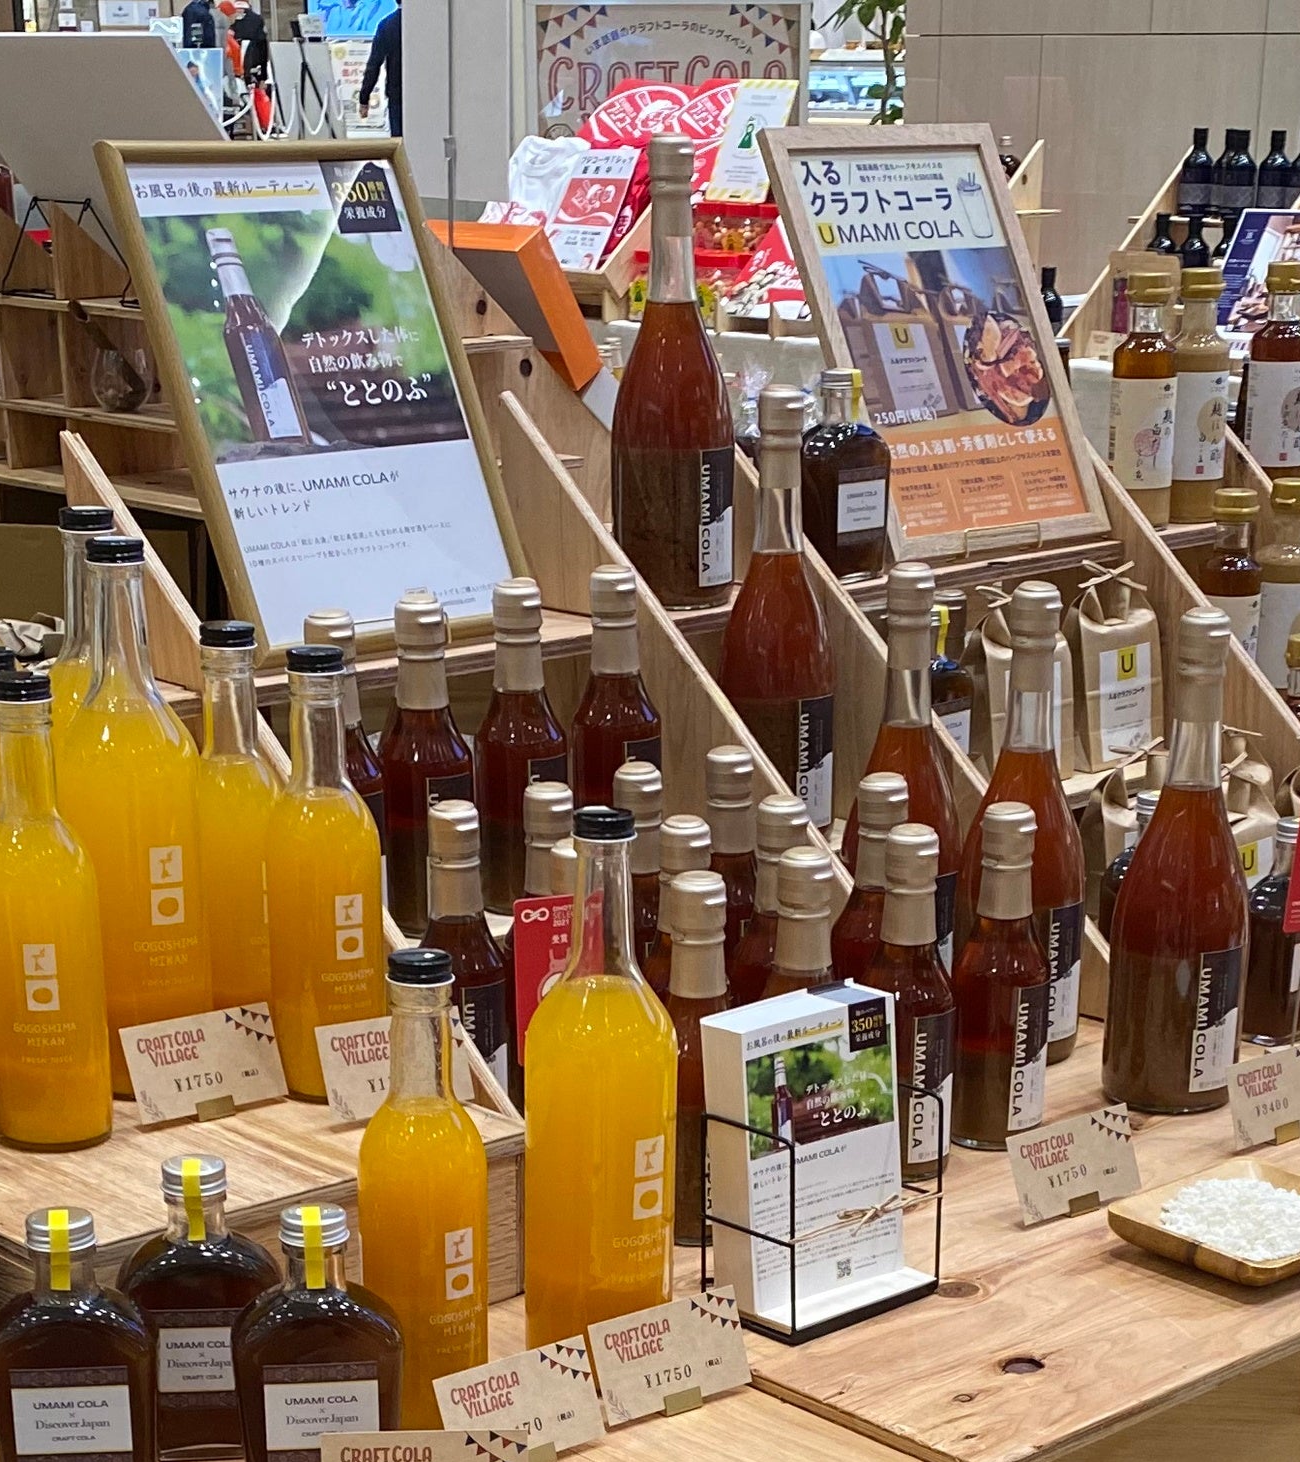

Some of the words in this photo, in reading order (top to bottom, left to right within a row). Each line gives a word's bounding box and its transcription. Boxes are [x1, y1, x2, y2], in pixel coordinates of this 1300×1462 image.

[800, 160, 841, 186] 入る
[134, 179, 316, 200] お風呂の後の最新ルーティーン
[810, 188, 953, 216] クラフトコーラ
[817, 221, 900, 245] UMAMI
[904, 219, 964, 240] COLA
[701, 464, 711, 526] UMAMI
[234, 499, 312, 521] 新しいトレンド
[701, 527, 711, 573] COLA
[1121, 653, 1134, 673] U
[799, 713, 810, 772] UMAMI
[149, 953, 188, 967] MIKAN
[321, 967, 375, 983] GOGOSHIMA
[333, 982, 367, 994] MIKAN
[1196, 967, 1212, 1030] UMAMI
[12, 1022, 77, 1034] GOGOSHIMA
[1014, 1003, 1029, 1068] UMAMI
[27, 1037, 66, 1047] MIKAN
[137, 1032, 174, 1055] CRAFT
[174, 1028, 205, 1046] COLA
[330, 1032, 368, 1052] CRAFT
[147, 1046, 199, 1068] VILLAGE
[1193, 1032, 1207, 1079] COLA
[174, 1070, 224, 1093] ¥1750
[1236, 1069, 1262, 1087] CRAFT
[1262, 1062, 1283, 1080] COLA
[1011, 1070, 1025, 1117] COLA
[1244, 1078, 1277, 1099] VILLAGE
[1255, 1097, 1289, 1117] ¥3400
[911, 1101, 925, 1149] COLA
[1020, 1138, 1050, 1160] CRAFT
[1050, 1132, 1075, 1149] COLA
[1029, 1148, 1070, 1171] VILLAGE
[1047, 1163, 1088, 1189] ¥1750
[443, 1322, 476, 1337] MIKAN
[604, 1325, 640, 1351] CRAFT
[640, 1318, 671, 1340] COLA
[166, 1341, 204, 1350] UMAMI
[614, 1337, 665, 1364] VILLAGE
[450, 1379, 488, 1406] CRAFT
[488, 1371, 521, 1395] COLA
[644, 1364, 693, 1389] ¥1750
[33, 1401, 74, 1410] UMAMI
[77, 1400, 109, 1409] COLA
[284, 1397, 325, 1406] UMAMI
[327, 1395, 358, 1404] COLA
[461, 1390, 515, 1420] VILLAGE
[393, 1445, 433, 1462] COLA
